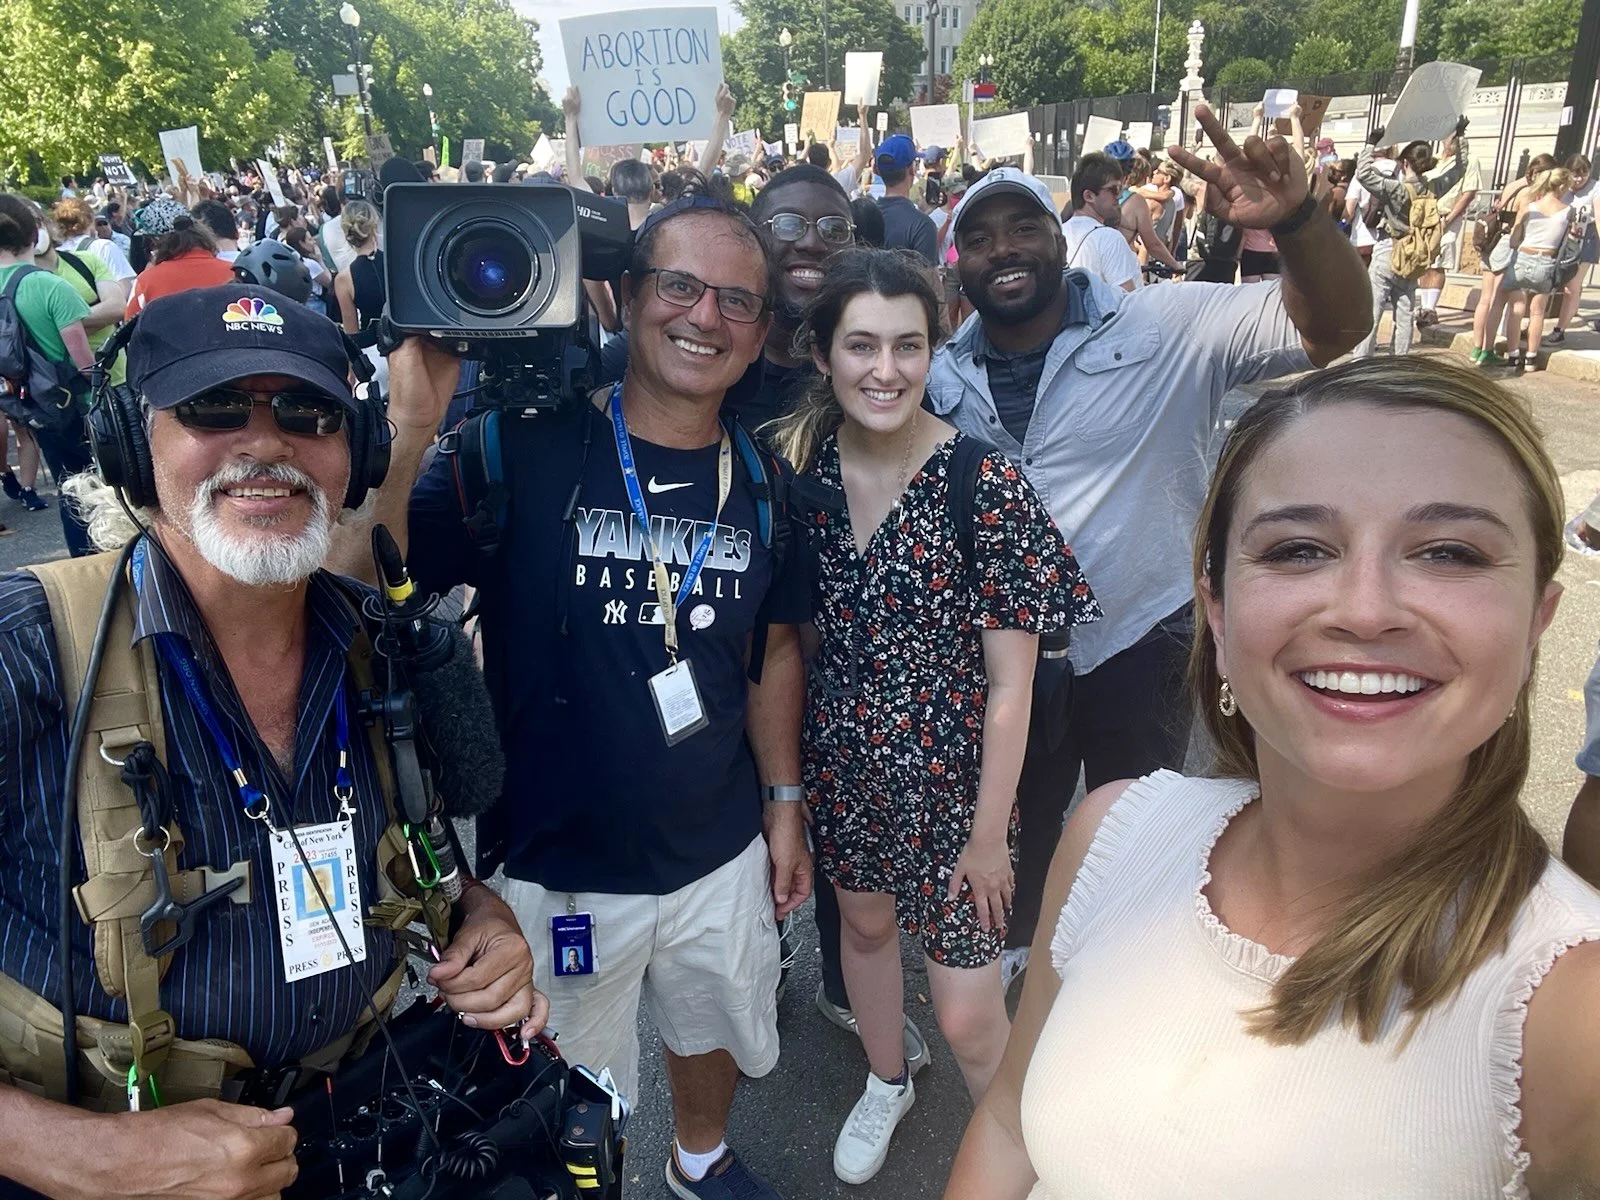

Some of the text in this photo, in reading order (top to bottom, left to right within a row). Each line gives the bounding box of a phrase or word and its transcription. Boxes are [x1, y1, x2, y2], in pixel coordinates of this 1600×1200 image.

[582, 28, 710, 72] ABORTION
[636, 68, 662, 86] IS
[606, 87, 697, 127] GOOD
[104, 165, 124, 176] NOT
[225, 322, 283, 335] NBC NEWS
[575, 507, 752, 572] YANKEES
[576, 564, 741, 599] BASEBALL
[603, 599, 628, 624] NY
[283, 841, 301, 850] Cit
[309, 835, 326, 845] New
[326, 832, 344, 842] York
[293, 850, 317, 864] 223
[345, 848, 360, 929] PRESS
[277, 862, 294, 947] PRESS
[289, 958, 318, 975] PRESS
